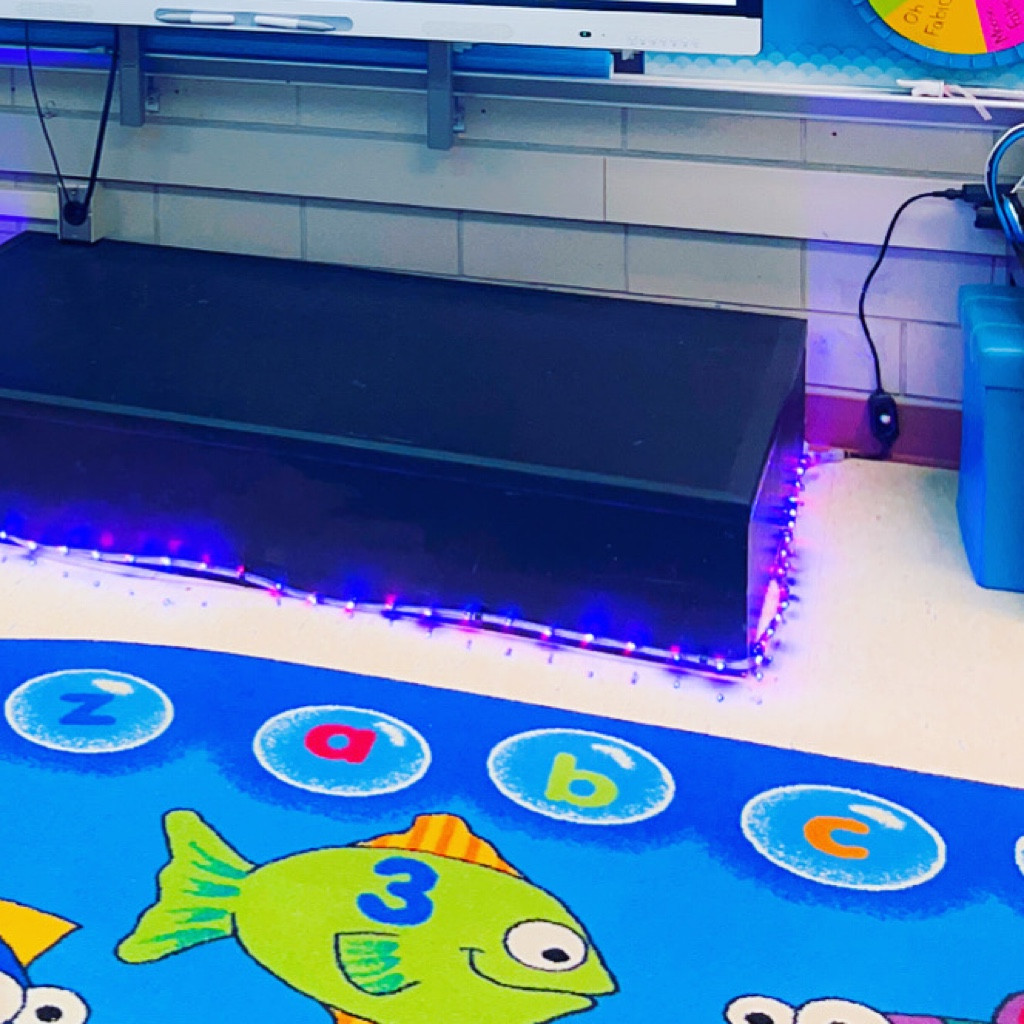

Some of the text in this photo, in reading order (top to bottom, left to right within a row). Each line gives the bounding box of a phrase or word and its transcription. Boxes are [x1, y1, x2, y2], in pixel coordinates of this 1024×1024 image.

[904, 3, 924, 24] Oh
[303, 723, 378, 766] a
[544, 752, 619, 808] b
[802, 814, 872, 862] c
[356, 856, 439, 927] 3
